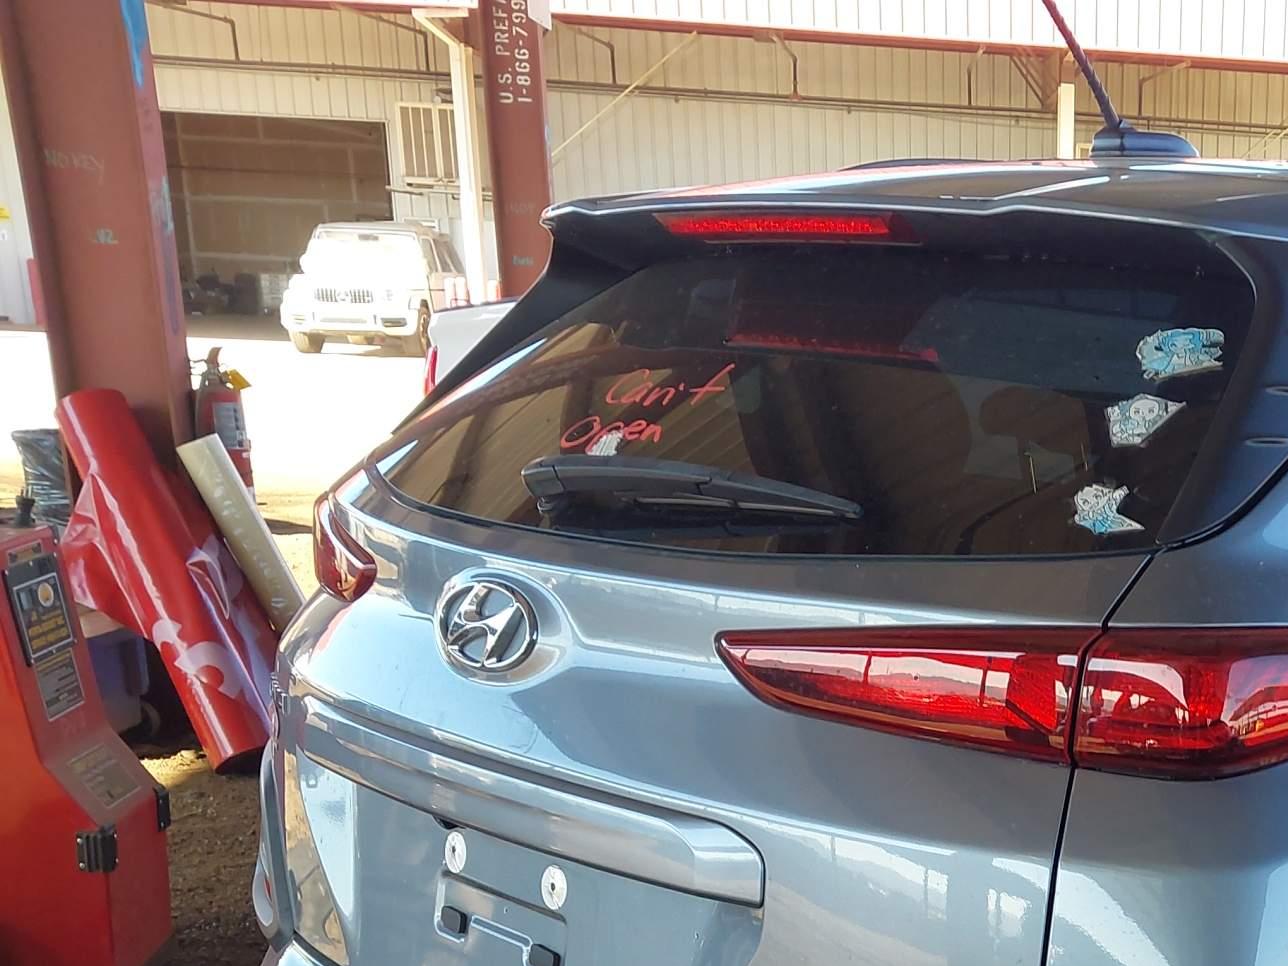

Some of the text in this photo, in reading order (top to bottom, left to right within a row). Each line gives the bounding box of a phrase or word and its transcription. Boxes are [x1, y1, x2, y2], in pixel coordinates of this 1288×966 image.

[493, 0, 514, 104] U.S. PREF
[606, 363, 736, 407] Can't
[560, 415, 663, 456] Open
